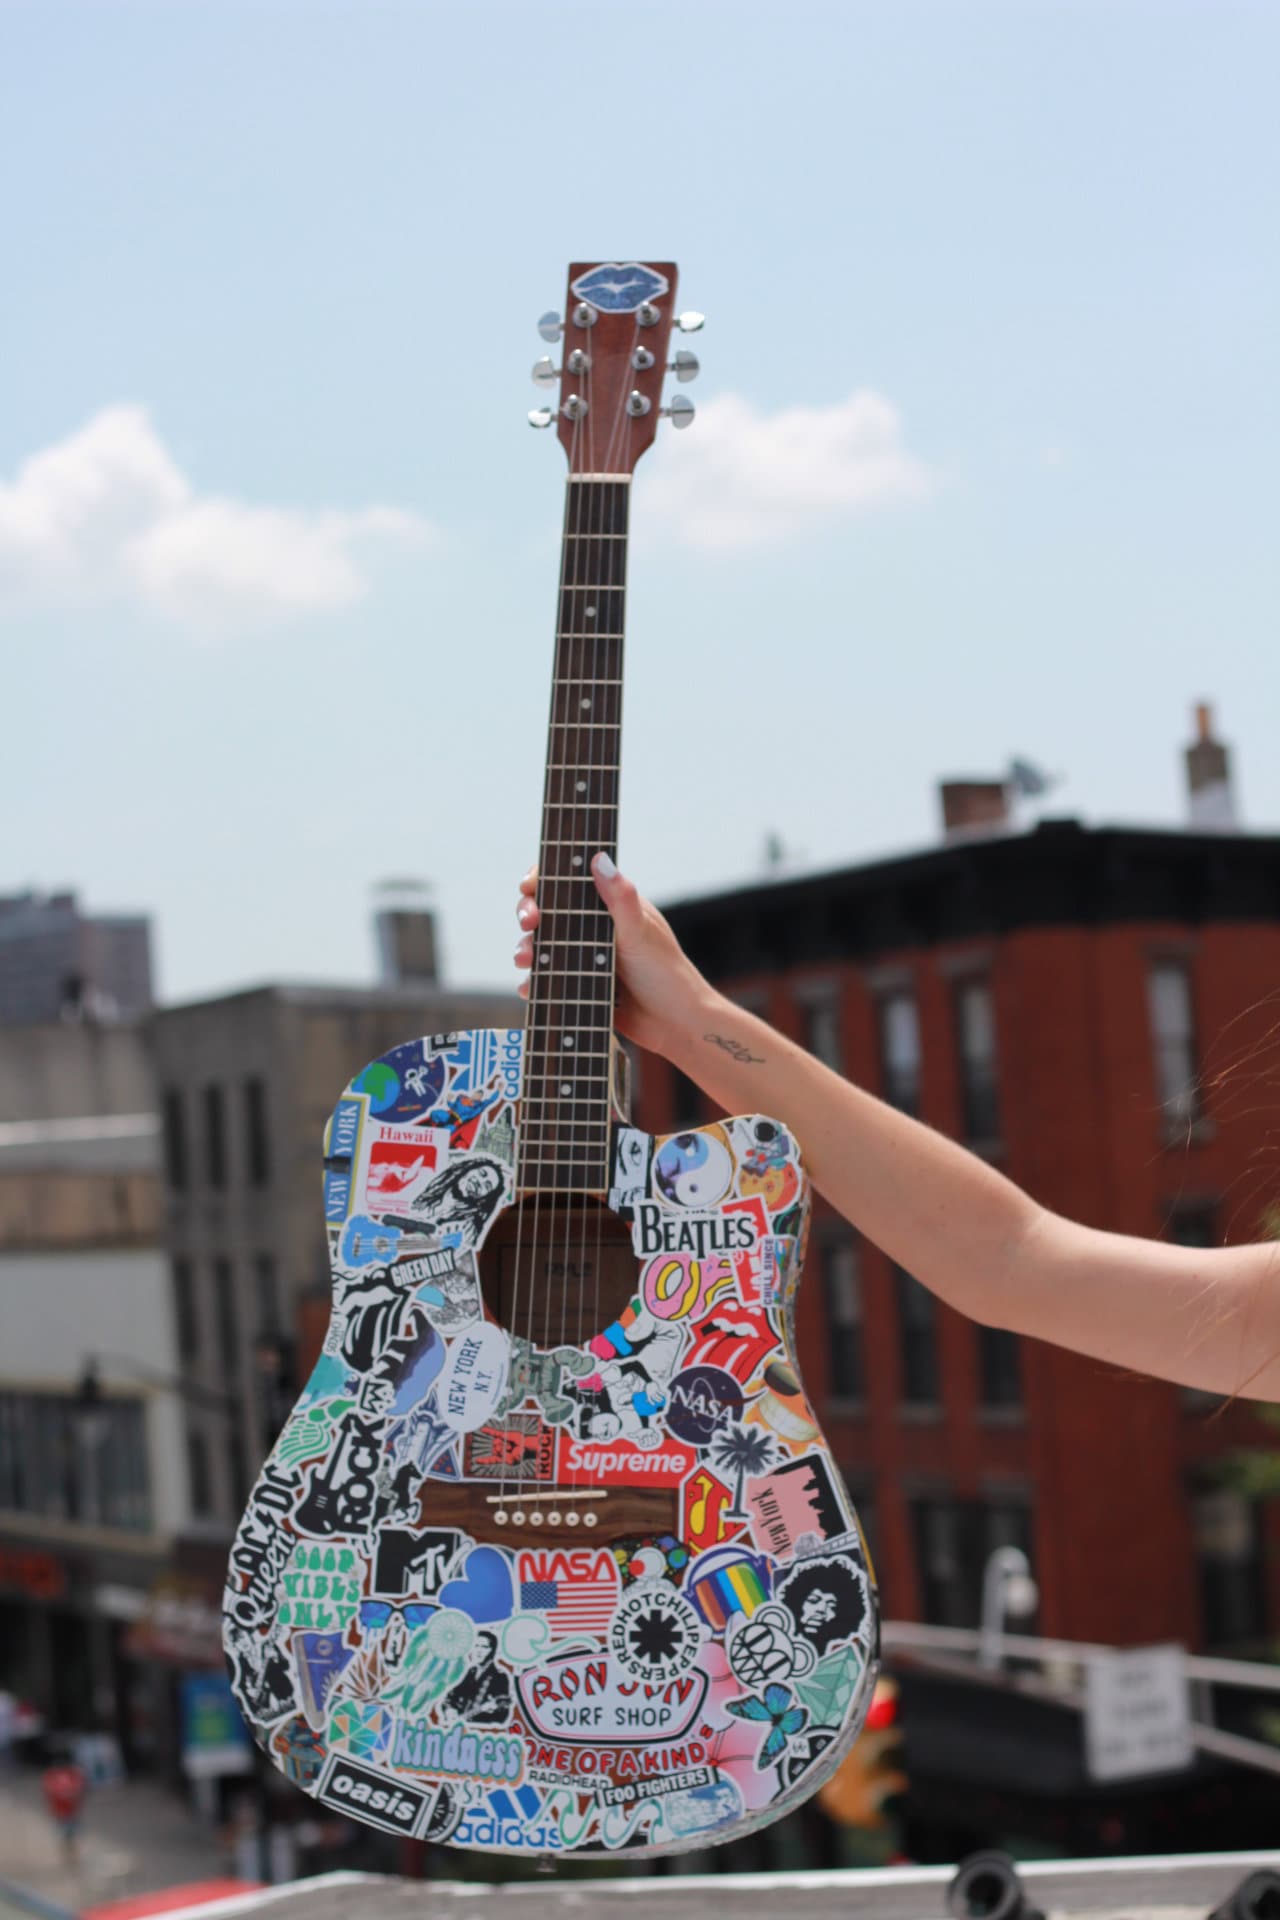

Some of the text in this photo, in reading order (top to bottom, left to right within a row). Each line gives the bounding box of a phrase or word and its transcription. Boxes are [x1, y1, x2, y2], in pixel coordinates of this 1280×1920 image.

[334, 1104, 358, 1156] YORK
[380, 1126, 434, 1143] Hawaii
[638, 1204, 755, 1260] BEATLES
[390, 1249, 455, 1288] GREEN DAY
[447, 1336, 483, 1416] NEW YORK
[671, 1384, 735, 1425] NASA
[337, 1415, 387, 1536] ROCK
[565, 1444, 687, 1480] Supreme
[233, 1530, 298, 1629] Queen
[295, 1545, 356, 1574] GOOD
[373, 1529, 473, 1597] MTV
[519, 1551, 618, 1584] NASA
[532, 1662, 608, 1710] RON
[552, 1706, 672, 1727] SURF SHOP
[393, 1718, 522, 1779] kindness
[525, 1739, 706, 1775] ONE OF A KIND
[331, 1774, 417, 1821] oasis
[528, 1769, 609, 1791] RADIOHEAD
[605, 1768, 707, 1804] FOO FIGHTERS
[453, 1818, 563, 1849] adidas
